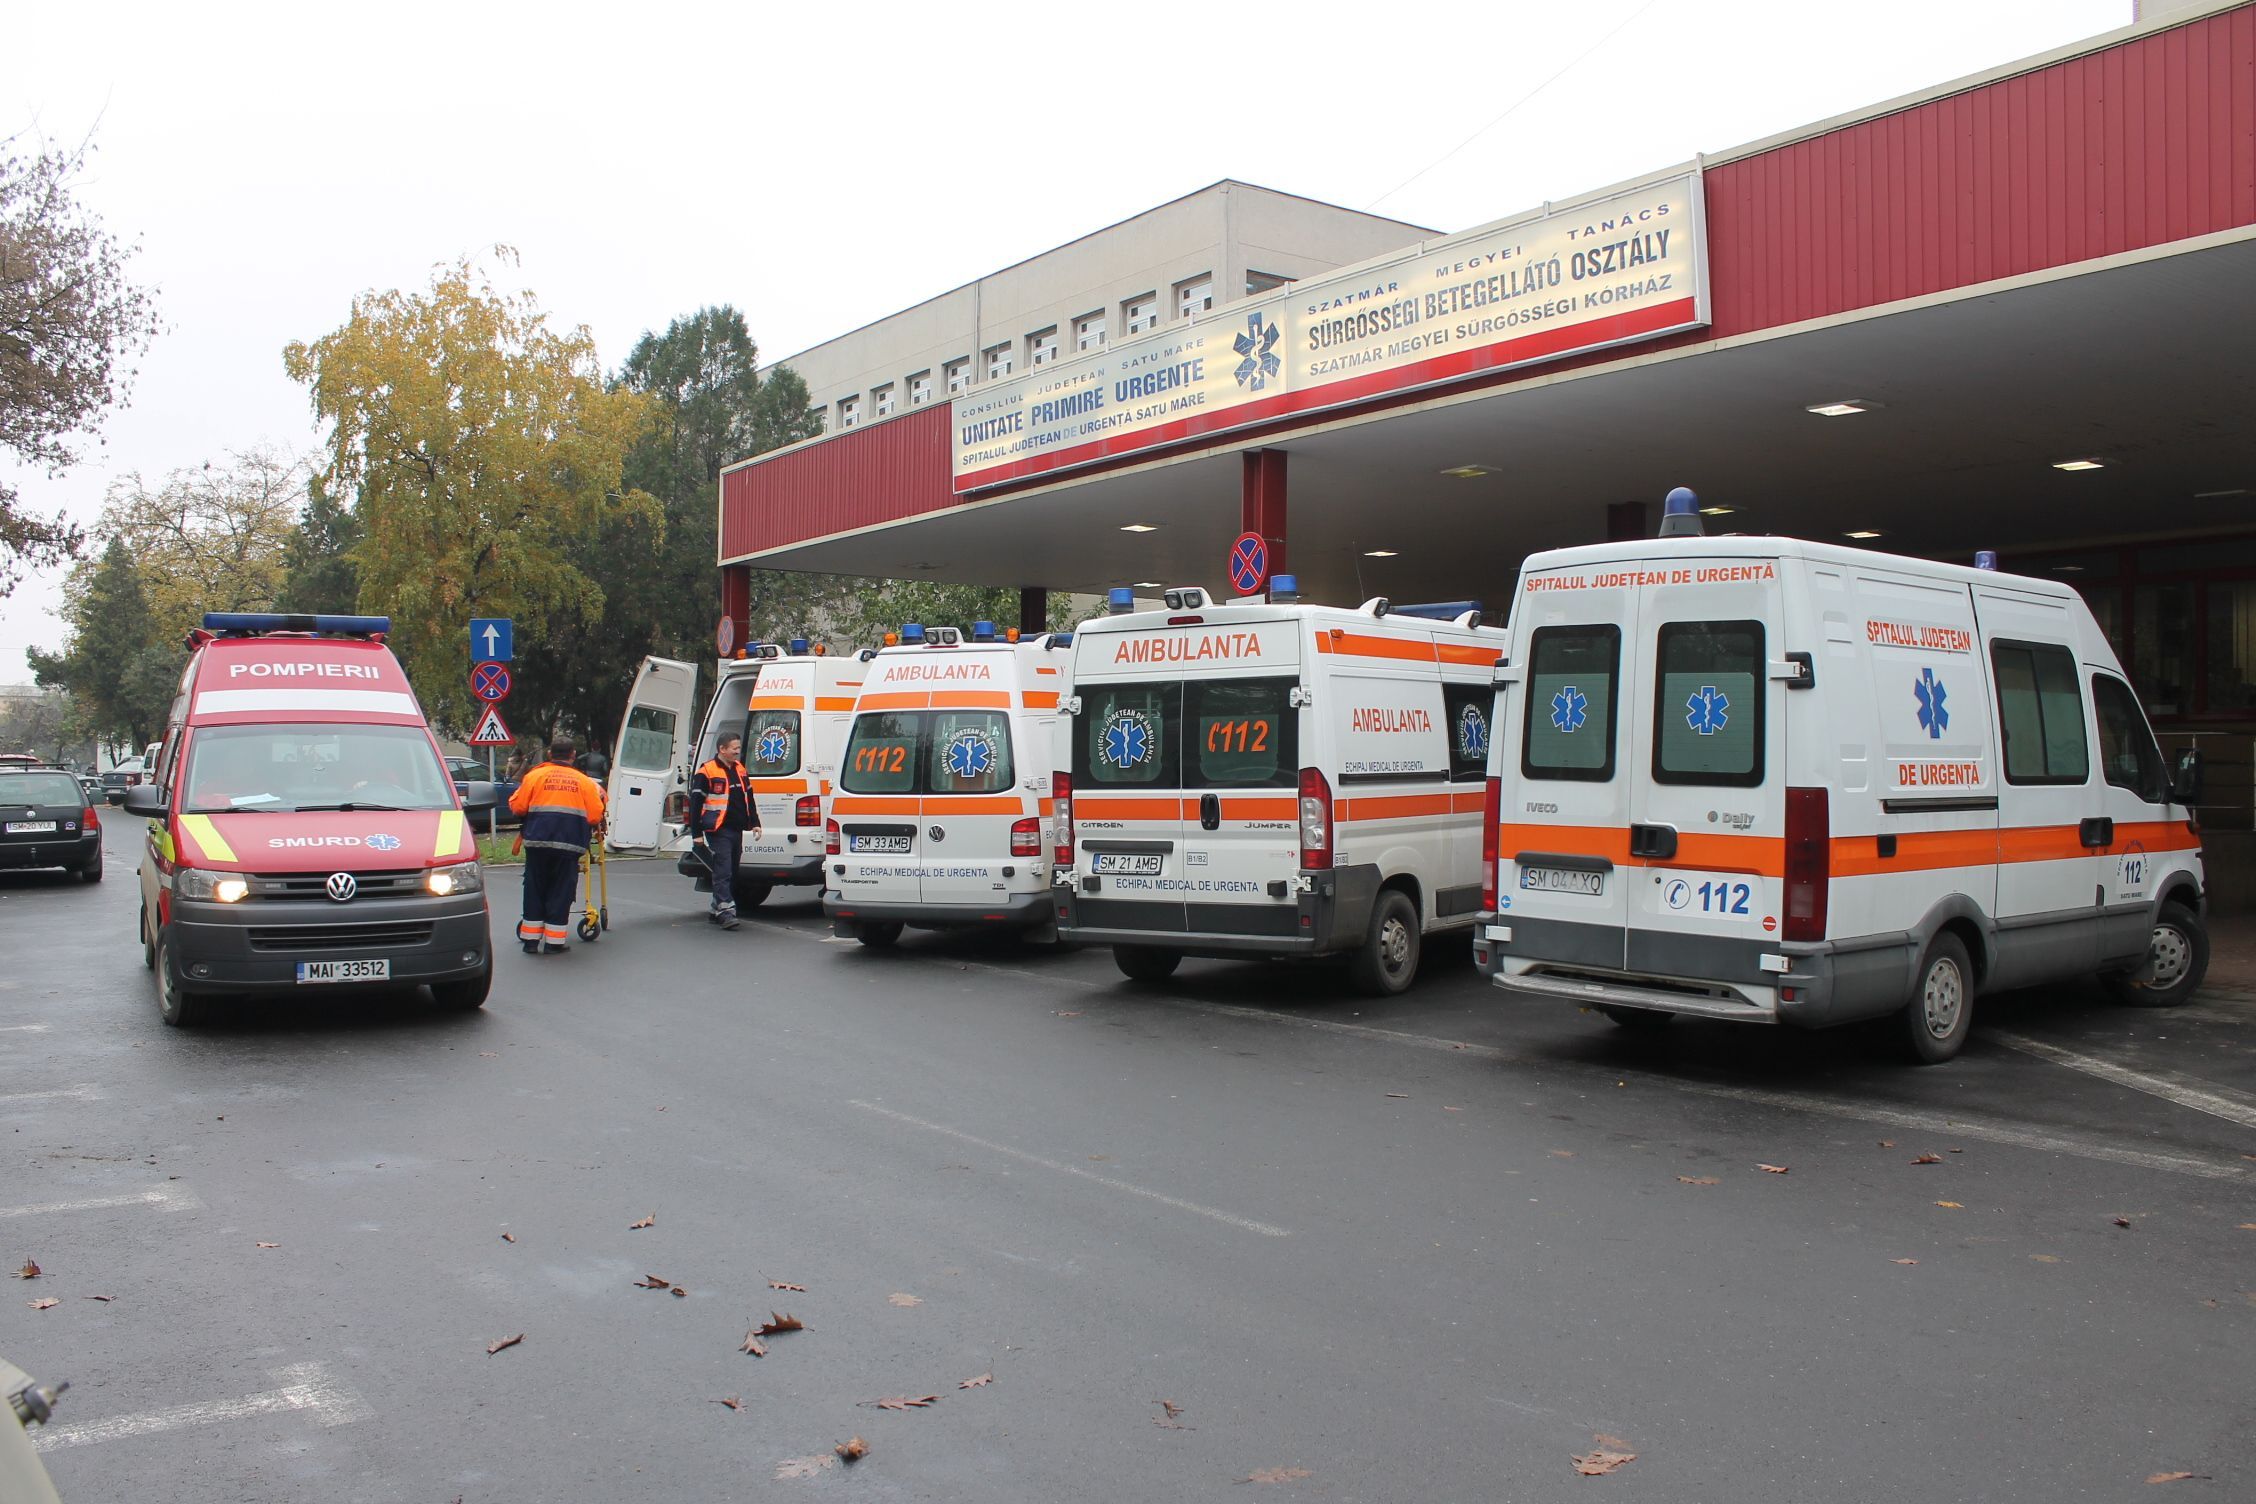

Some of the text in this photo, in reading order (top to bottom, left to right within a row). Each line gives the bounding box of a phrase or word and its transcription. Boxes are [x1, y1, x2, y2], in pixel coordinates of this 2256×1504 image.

[1307, 203, 1670, 315] SZATMÁR MEGYEI TANÁCS
[1309, 228, 1670, 351] SÜRGŐSSÉGI BETEGELLÁTÓ OSZTÁLY
[1309, 347, 1383, 376] SZATMÁR
[1388, 331, 1449, 356] MEGYEI
[1584, 274, 1672, 308] KÓRHÁZ
[961, 393, 1024, 418] CONSILIUL
[1121, 353, 1158, 370] SATU
[1164, 337, 1205, 357] MARE
[962, 410, 1023, 446] UNITATE
[1031, 386, 1104, 427] PRIMIRE
[962, 445, 1007, 466] SPITALUL
[1063, 427, 1077, 440] DE
[1136, 405, 1167, 422] SATU
[1170, 392, 1205, 412] MARE
[1526, 575, 1588, 592] SPITALUL
[1671, 570, 1692, 584] DE
[1867, 620, 1918, 646] SPITALUL
[1115, 633, 1261, 664] AMBULANTA
[230, 663, 379, 680] POMPIERII
[884, 664, 991, 682] AMBULANTA
[1353, 708, 1432, 733] AMBULANTA
[1098, 709, 1155, 765] SERVICIUL JUDETEAN DE AMBULANTA
[1220, 720, 1269, 752] 112
[866, 747, 905, 772] 112
[942, 743, 951, 775] SERVICIUL
[950, 728, 979, 742] JUDETEAN
[979, 730, 987, 739] DE
[1345, 761, 1424, 772] ECHIPAJ MEDICAL DE URGENTA
[1899, 764, 1917, 786] DE
[1526, 802, 1558, 813] IVECO
[1722, 812, 1755, 824] Daily
[268, 836, 361, 848] SMURD
[857, 837, 909, 849] SM 33 AMB
[860, 867, 988, 878] ECHIPAJ MEDICAL DE URGENTA
[1100, 857, 1158, 871] SM 21 AMB
[2125, 860, 2142, 884] 112
[1116, 878, 1259, 892] ECHIPAJ MEDICAL DE URGENTA
[1528, 869, 1546, 887] SM
[1698, 881, 1750, 914] 112
[309, 962, 386, 979] MAI 33512
